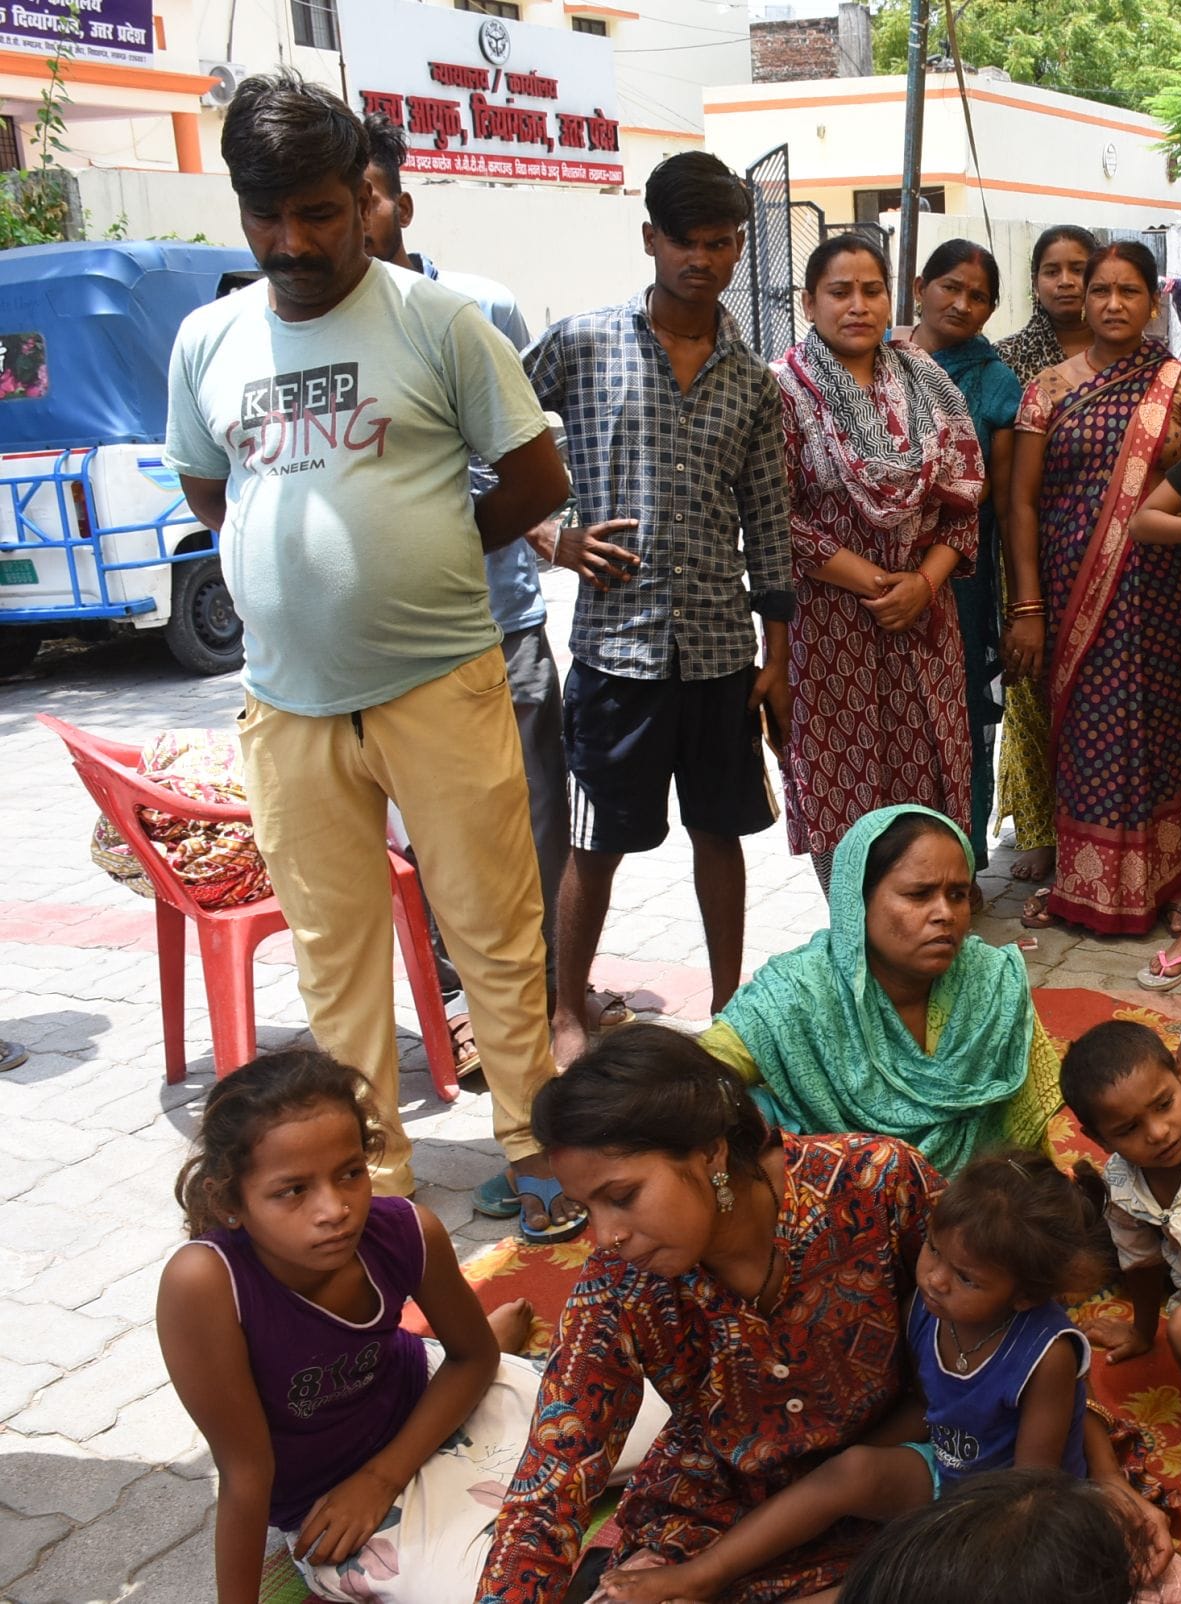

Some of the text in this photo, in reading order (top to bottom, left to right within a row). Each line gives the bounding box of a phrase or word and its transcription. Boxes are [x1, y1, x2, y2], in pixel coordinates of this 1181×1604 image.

[88, 20, 114, 40] उत्तर
[117, 22, 146, 45] प्रदेश
[428, 61, 490, 90] न्यायालय
[505, 70, 558, 99] कार्यालय
[556, 112, 586, 149] उत्तर
[587, 108, 620, 152] प्रदेश
[244, 373, 354, 420] KEEP
[225, 393, 393, 473] GOING
